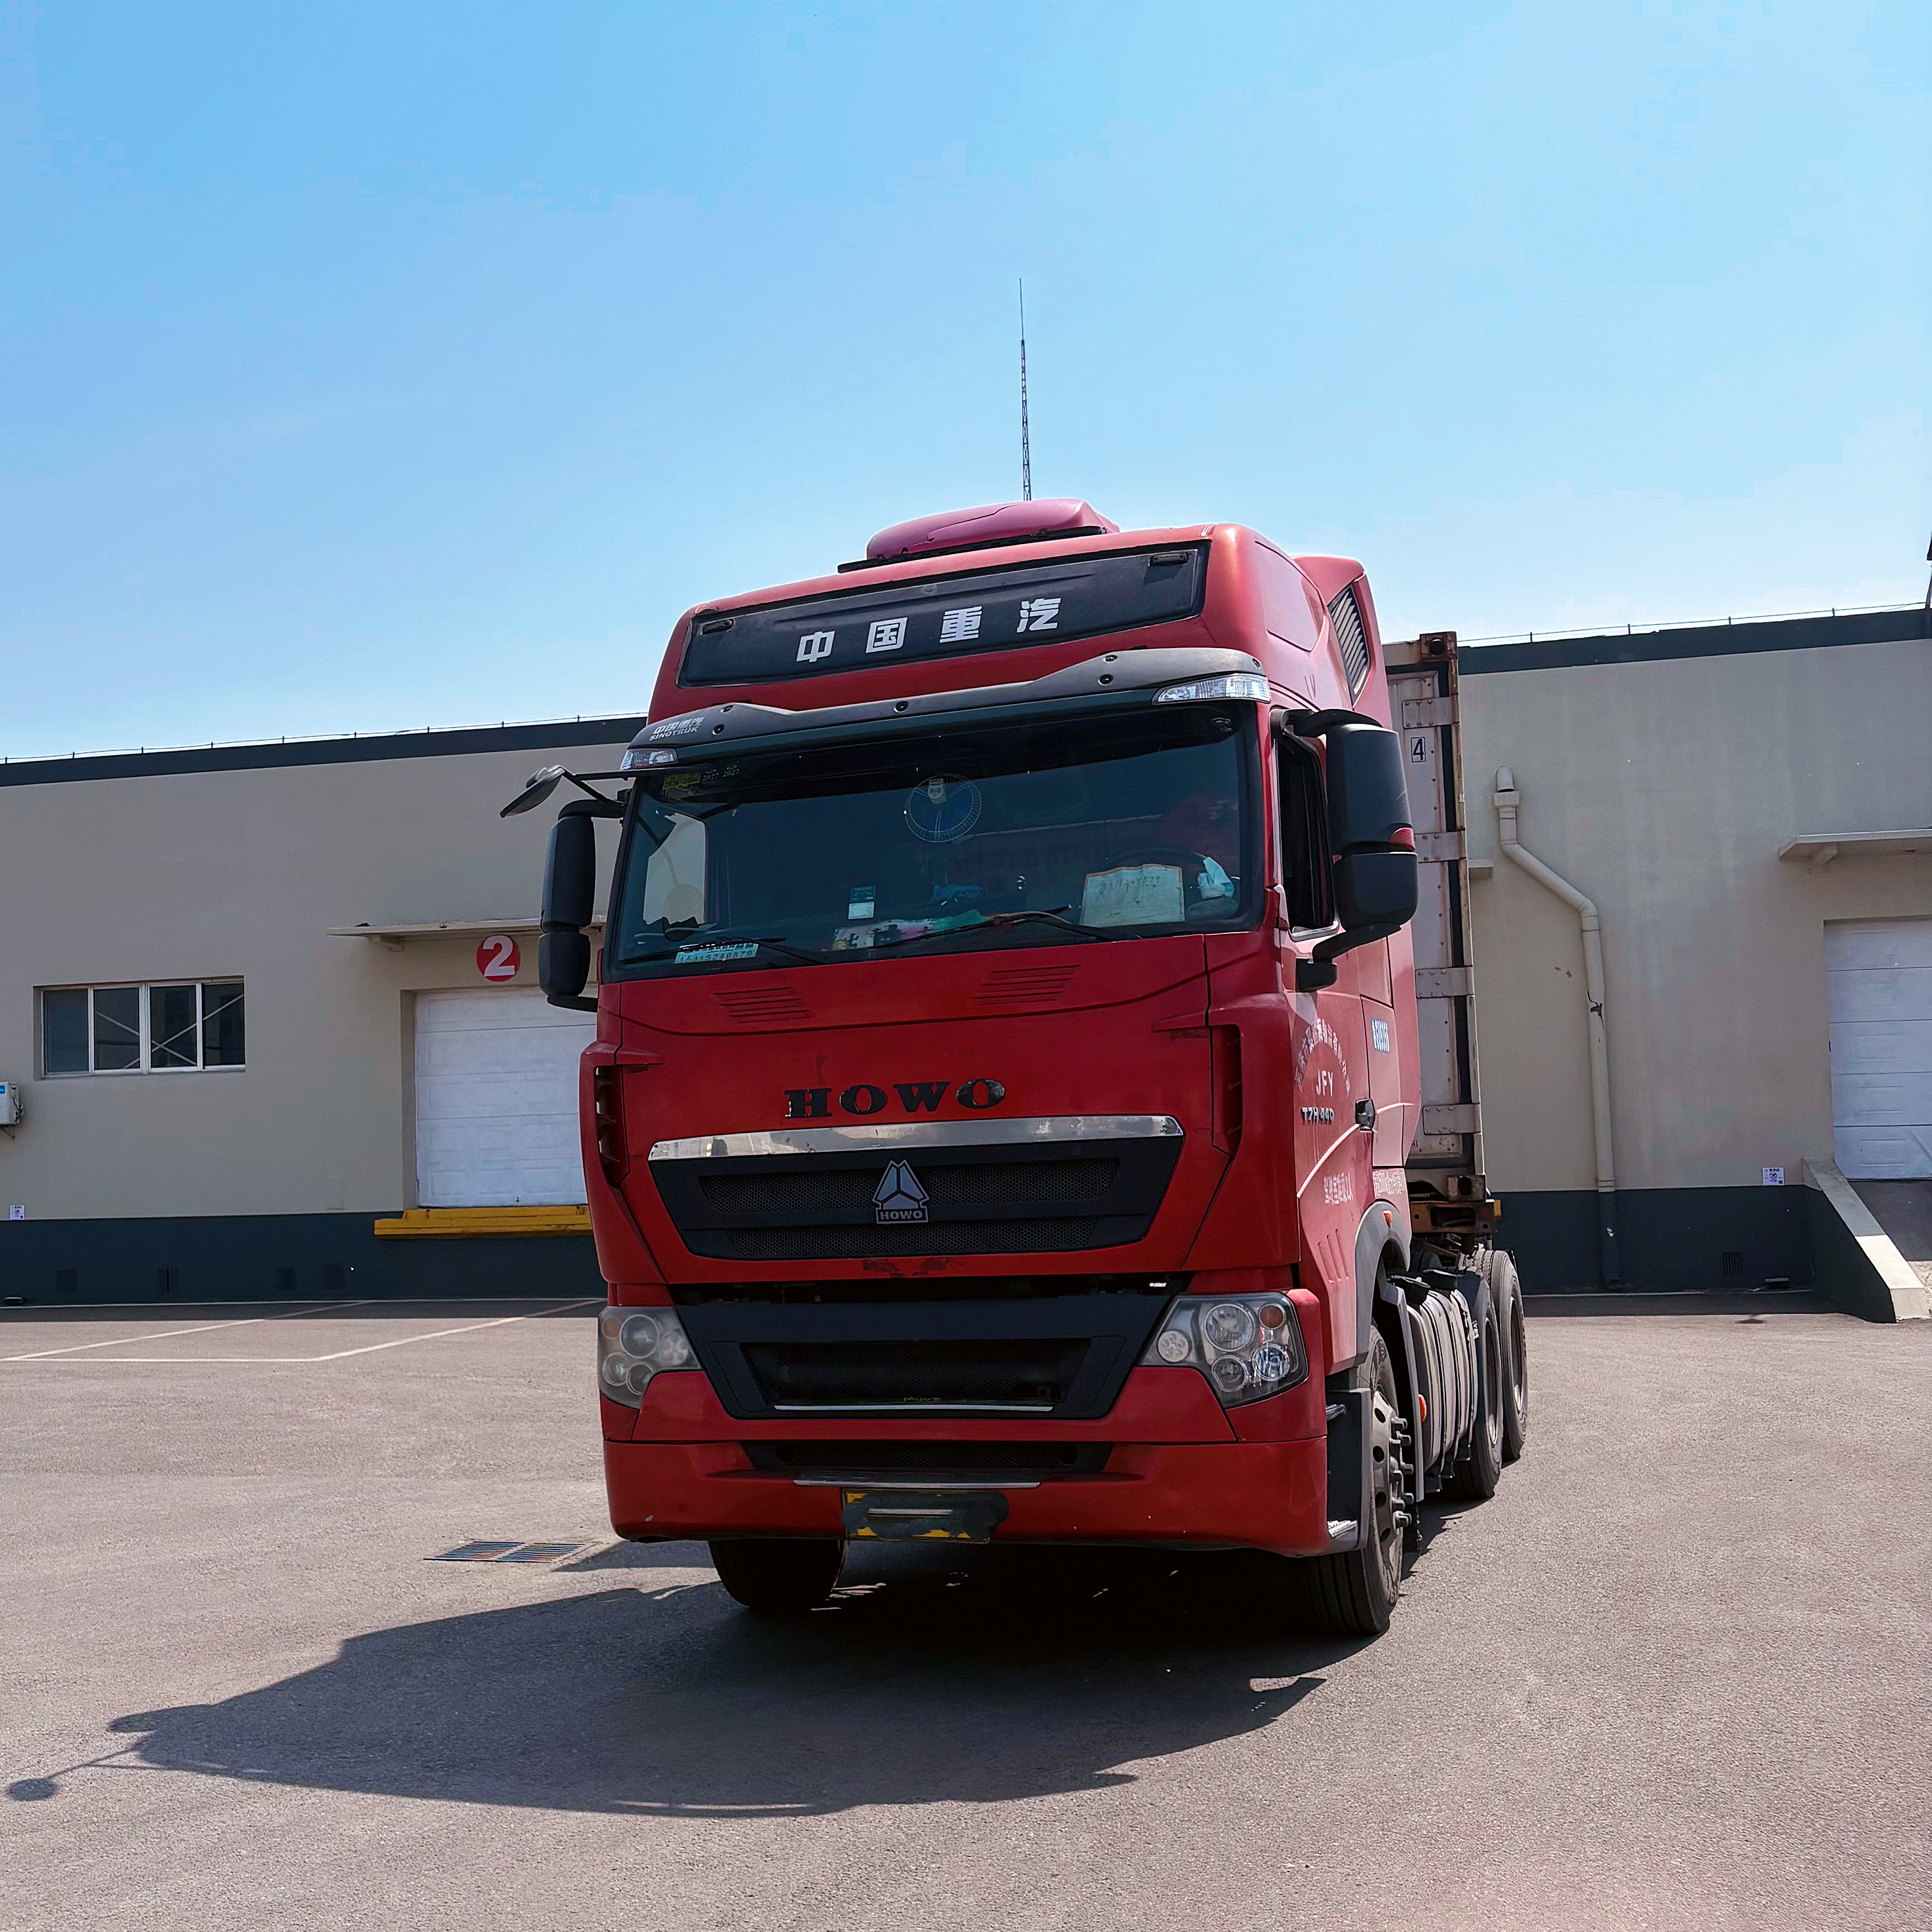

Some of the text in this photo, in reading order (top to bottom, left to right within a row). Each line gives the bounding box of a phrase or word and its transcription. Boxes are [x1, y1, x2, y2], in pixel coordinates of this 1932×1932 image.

[796, 598, 1061, 662] 中国重汽
[649, 726, 700, 741] SINOTRUK
[1413, 738, 1424, 760] 4
[483, 935, 515, 977] 2
[1316, 1069, 1333, 1097] JFY
[784, 1078, 1005, 1118] HOWO
[880, 1210, 923, 1220] HOWO
